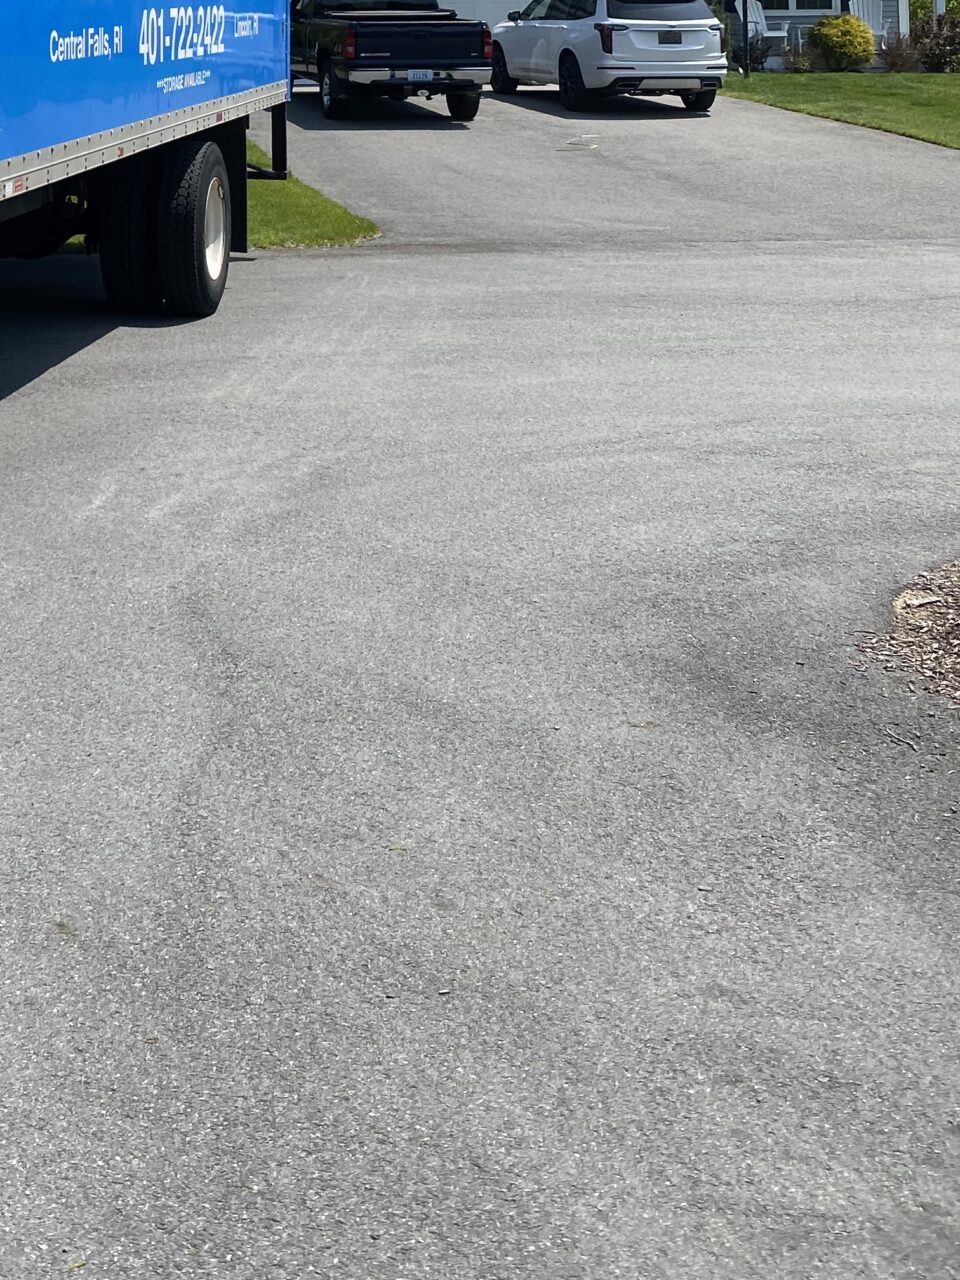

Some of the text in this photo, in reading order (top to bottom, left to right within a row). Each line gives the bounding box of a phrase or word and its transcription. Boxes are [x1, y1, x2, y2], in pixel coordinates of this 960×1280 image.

[49, 25, 123, 63] Central Falls, RI
[139, 5, 225, 66] 401-722-2422
